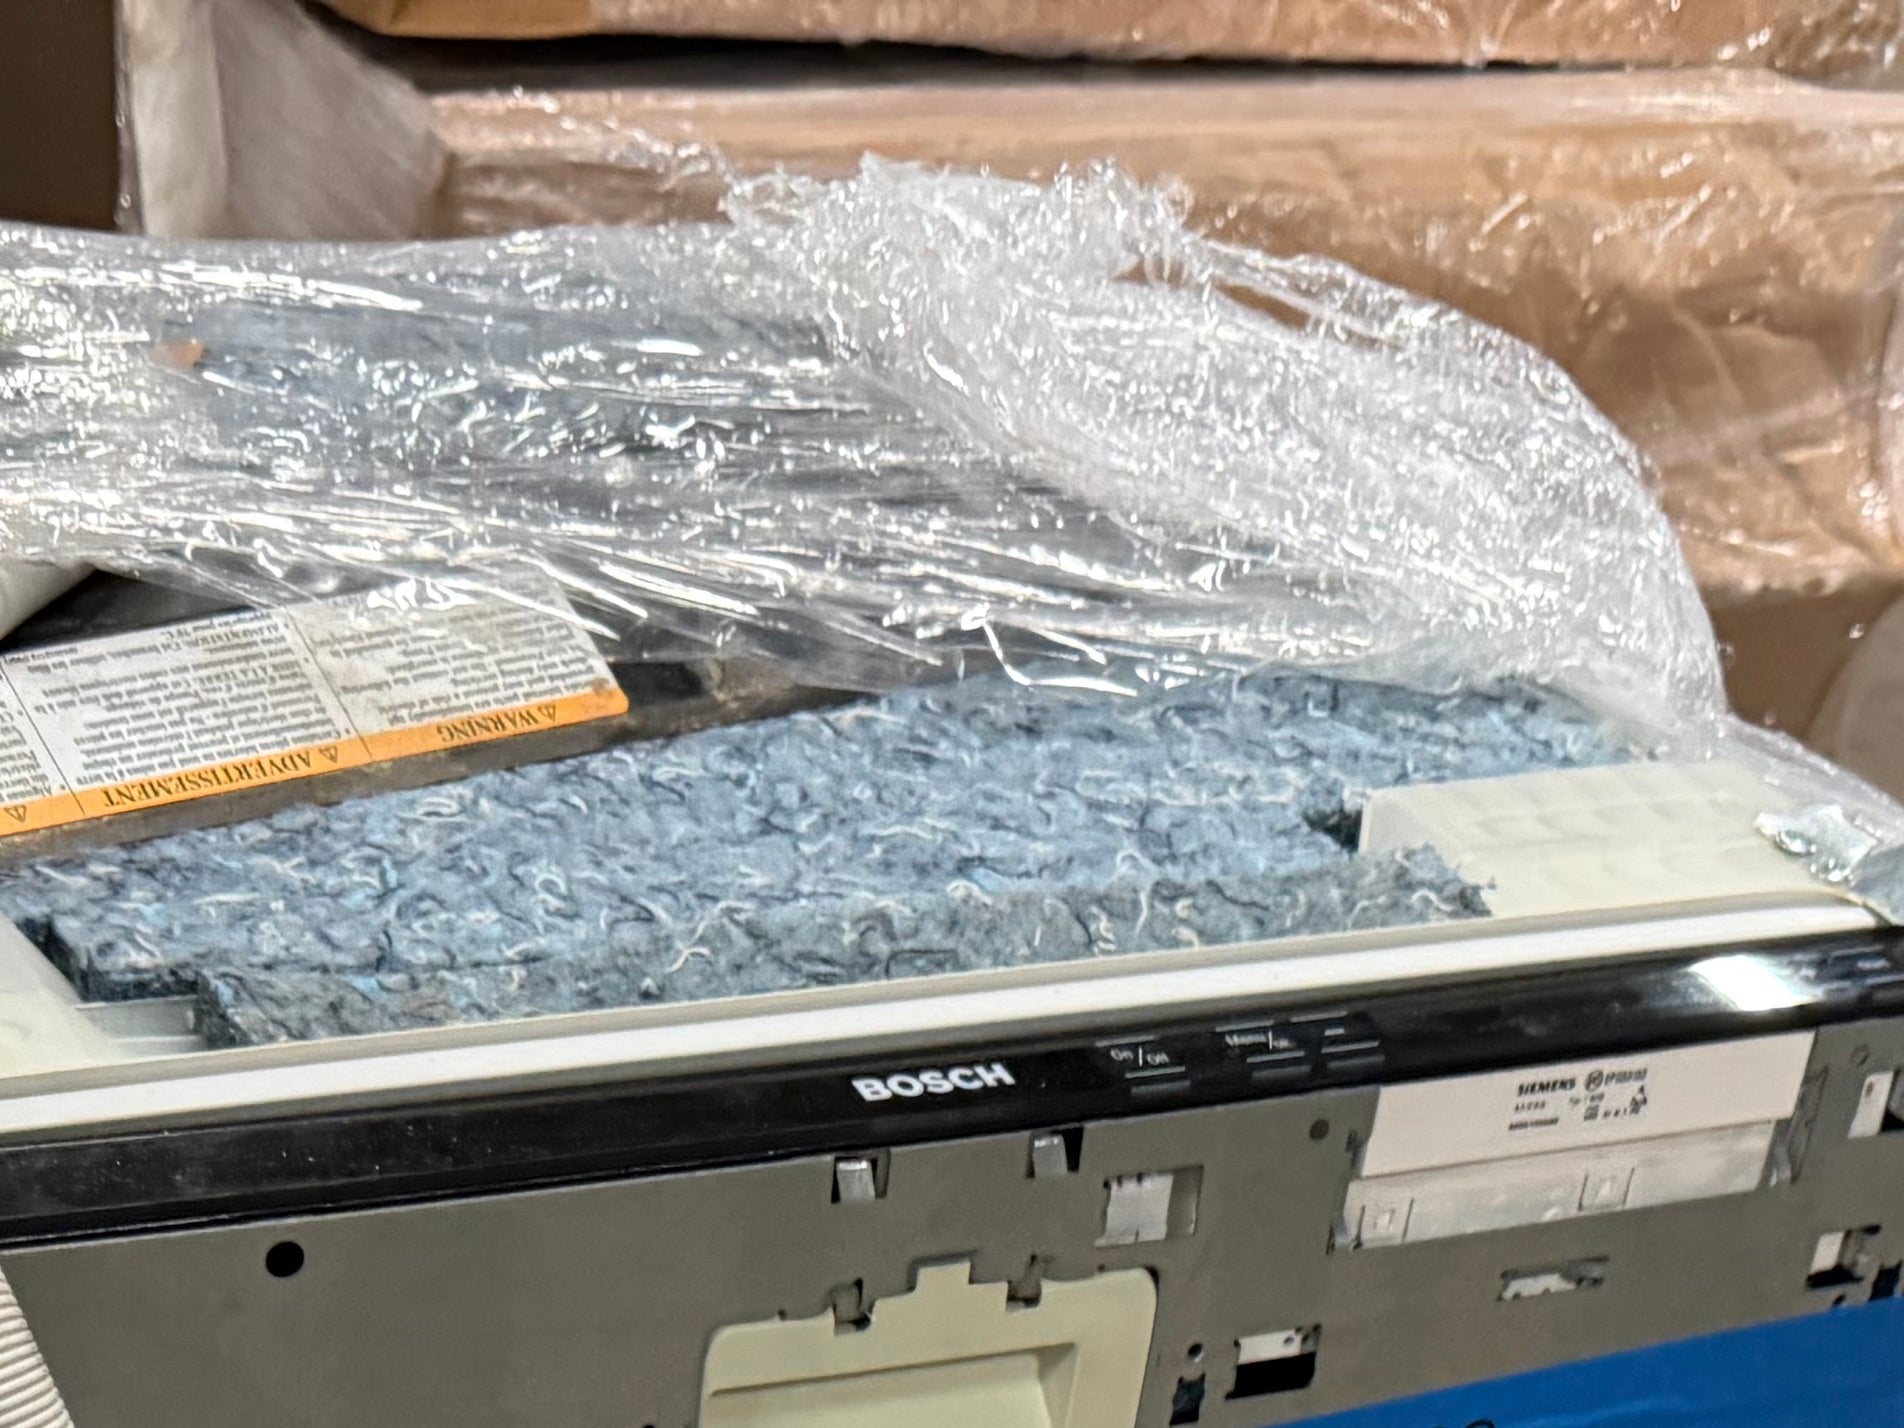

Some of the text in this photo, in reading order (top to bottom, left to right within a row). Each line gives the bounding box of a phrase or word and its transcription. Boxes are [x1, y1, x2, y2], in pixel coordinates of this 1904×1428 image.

[437, 708, 539, 742] WARNING
[101, 750, 311, 807] ADVERTISSEMENT
[851, 1062, 1016, 1102] BOSCH
[1517, 1077, 1576, 1097] SIEMENS
